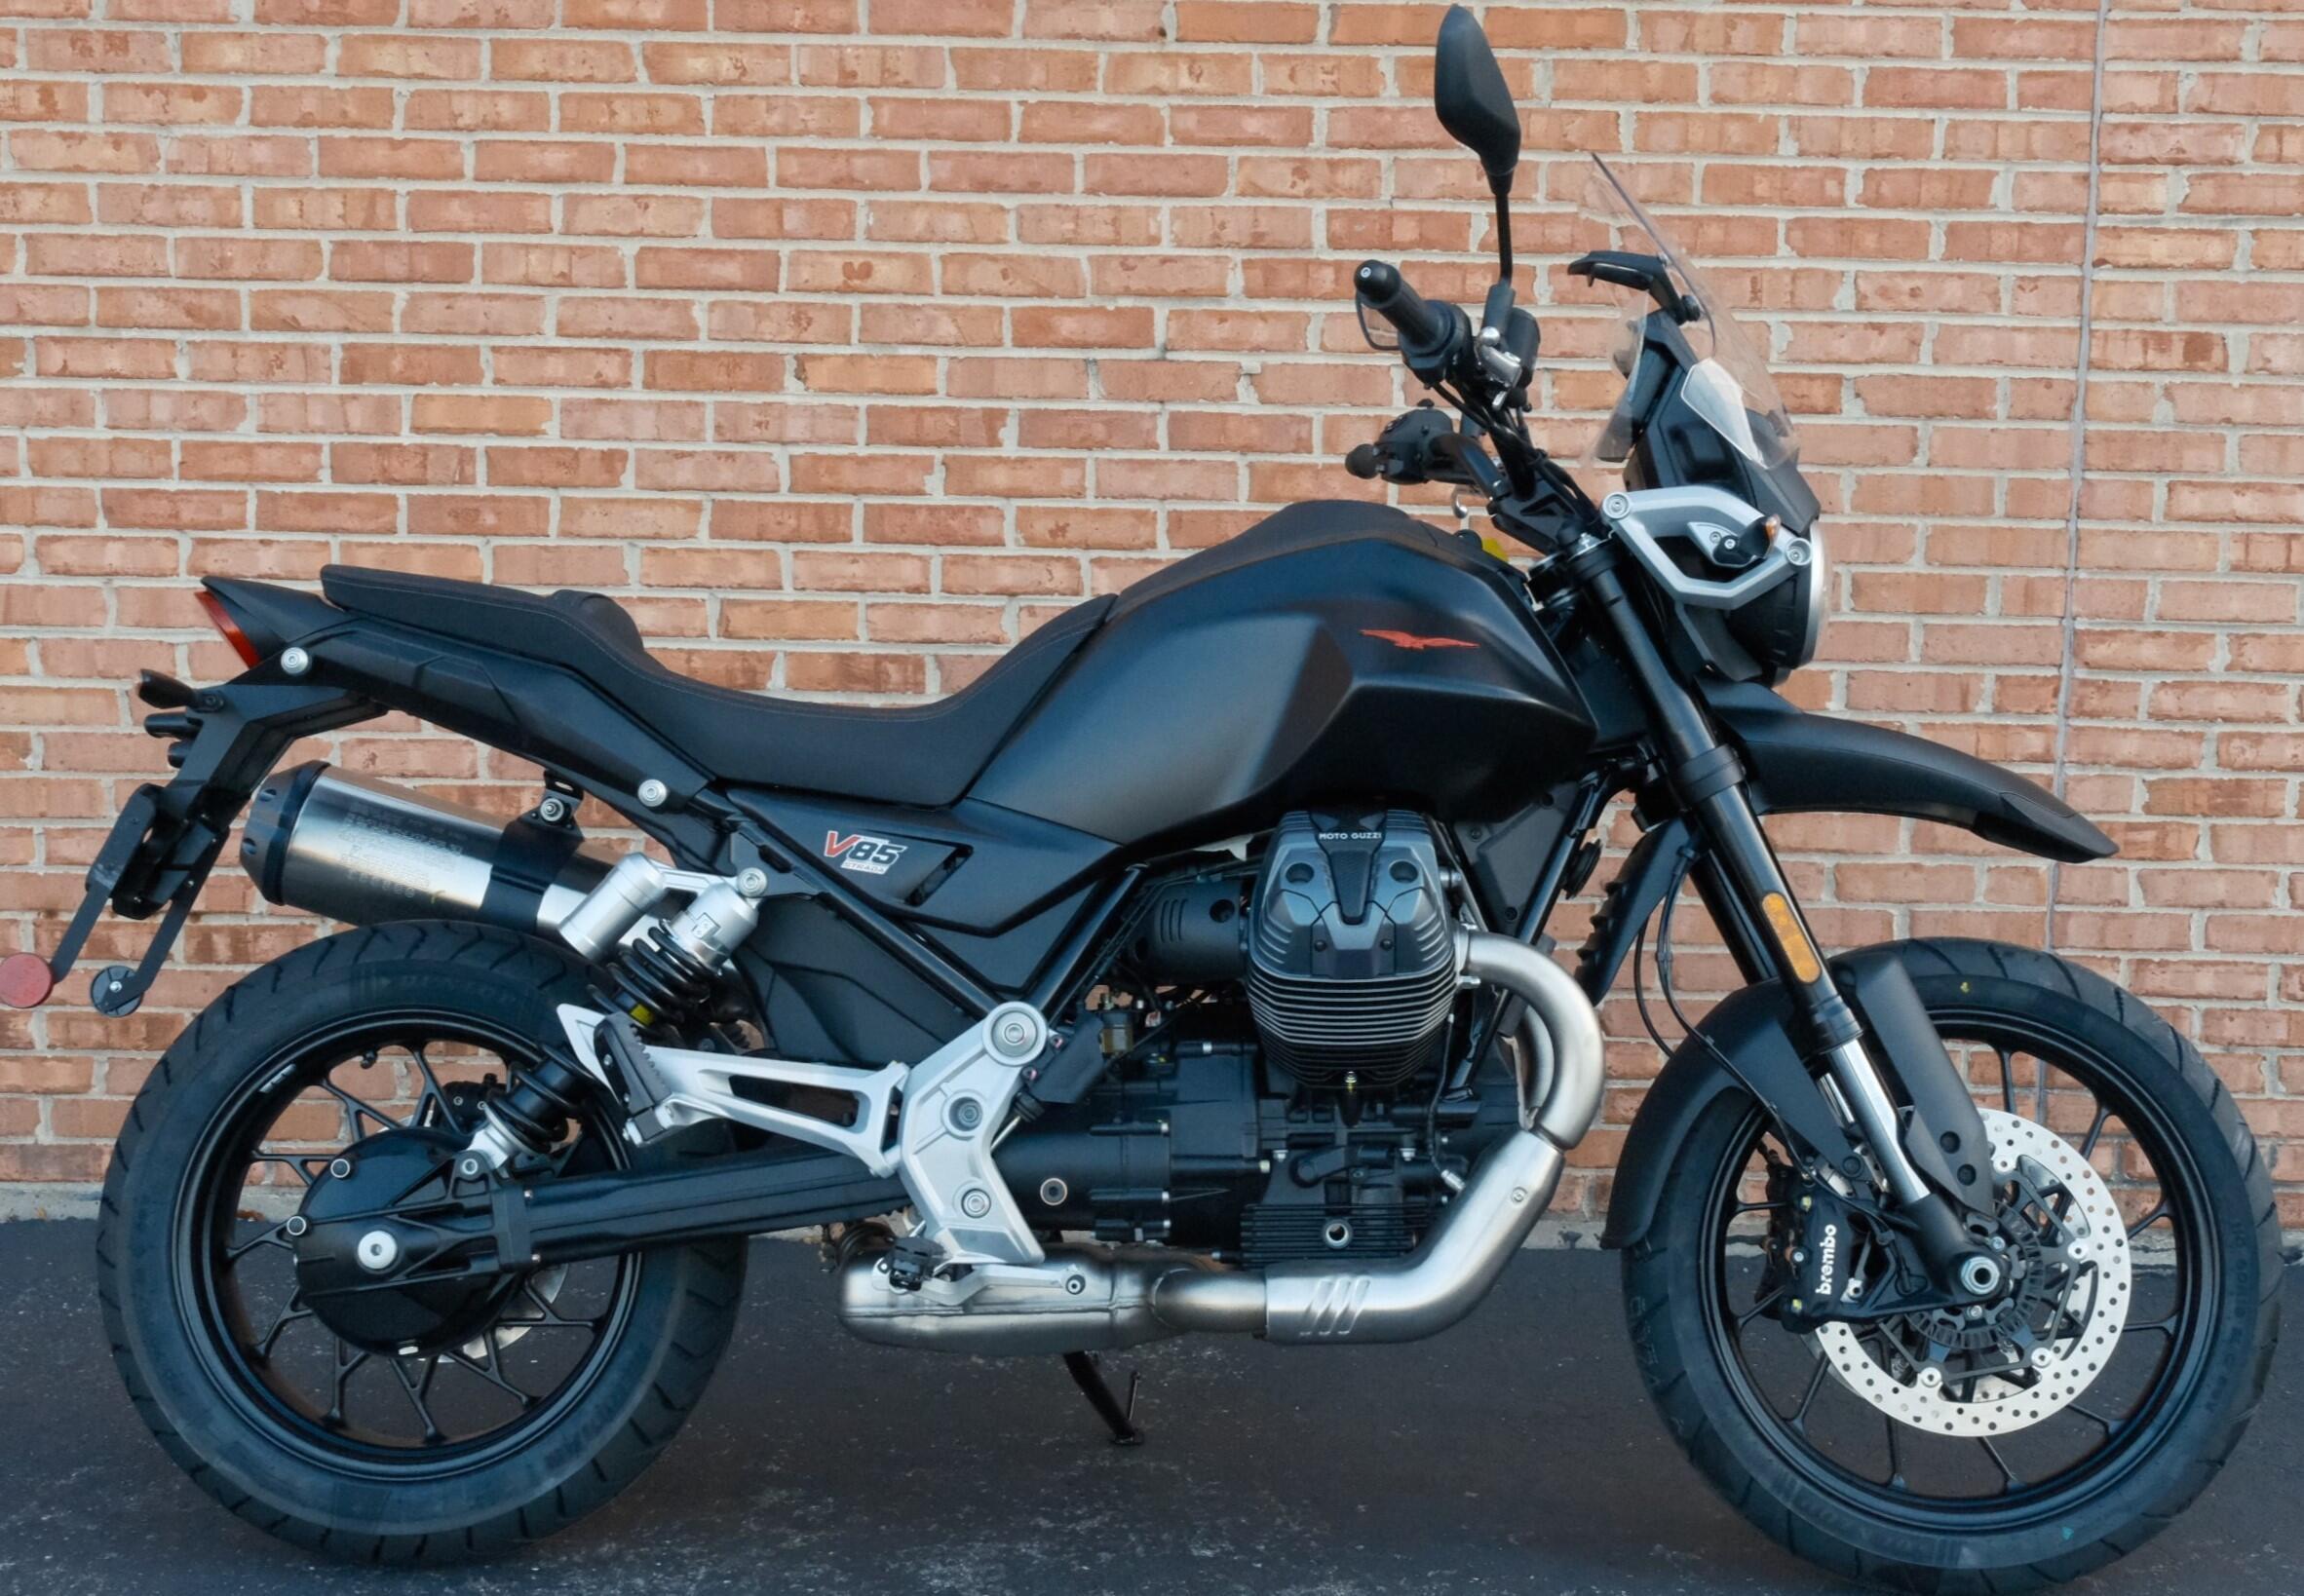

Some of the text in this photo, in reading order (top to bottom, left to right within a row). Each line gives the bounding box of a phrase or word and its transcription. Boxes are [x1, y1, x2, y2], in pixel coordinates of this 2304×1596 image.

[824, 830, 908, 865] V85
[843, 861, 885, 873] STRADA
[1815, 1224, 1837, 1295] brembo
